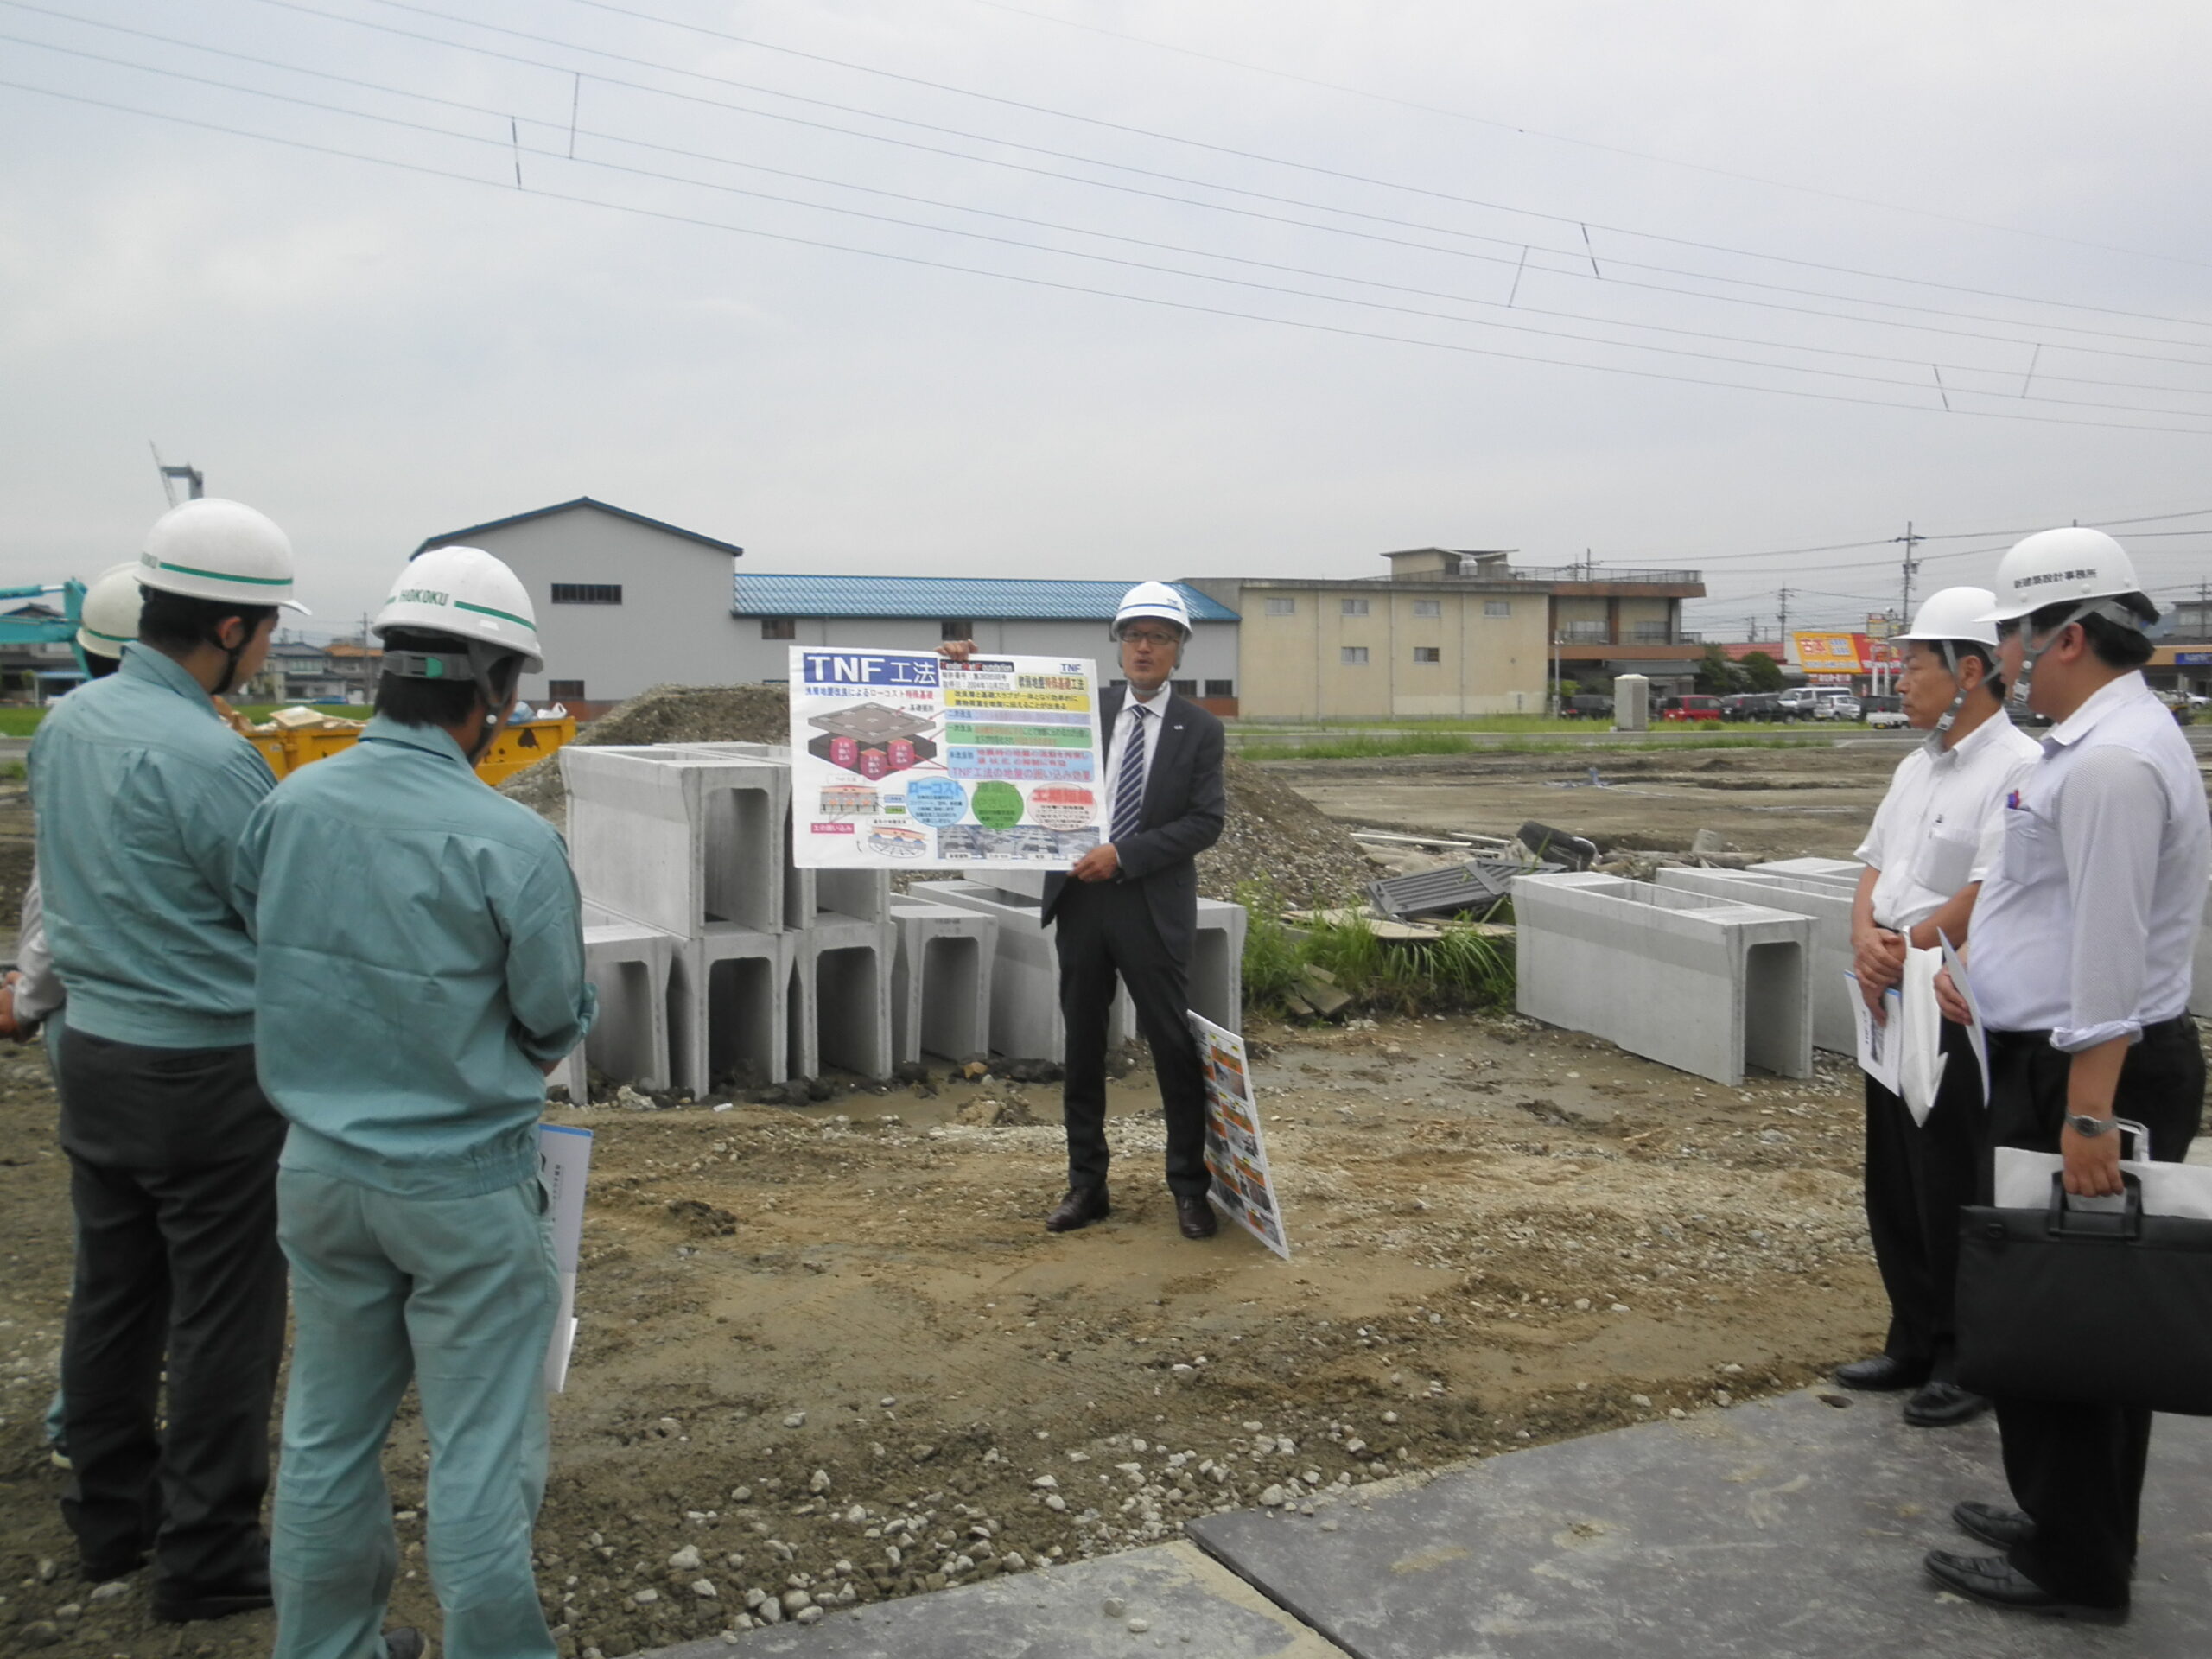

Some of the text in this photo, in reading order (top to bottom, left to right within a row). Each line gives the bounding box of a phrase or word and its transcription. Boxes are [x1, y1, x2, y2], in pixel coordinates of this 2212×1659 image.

[399, 589, 449, 606] HOKOKU
[807, 657, 937, 684] TNF 工法
[1060, 664, 1082, 672] TNF
